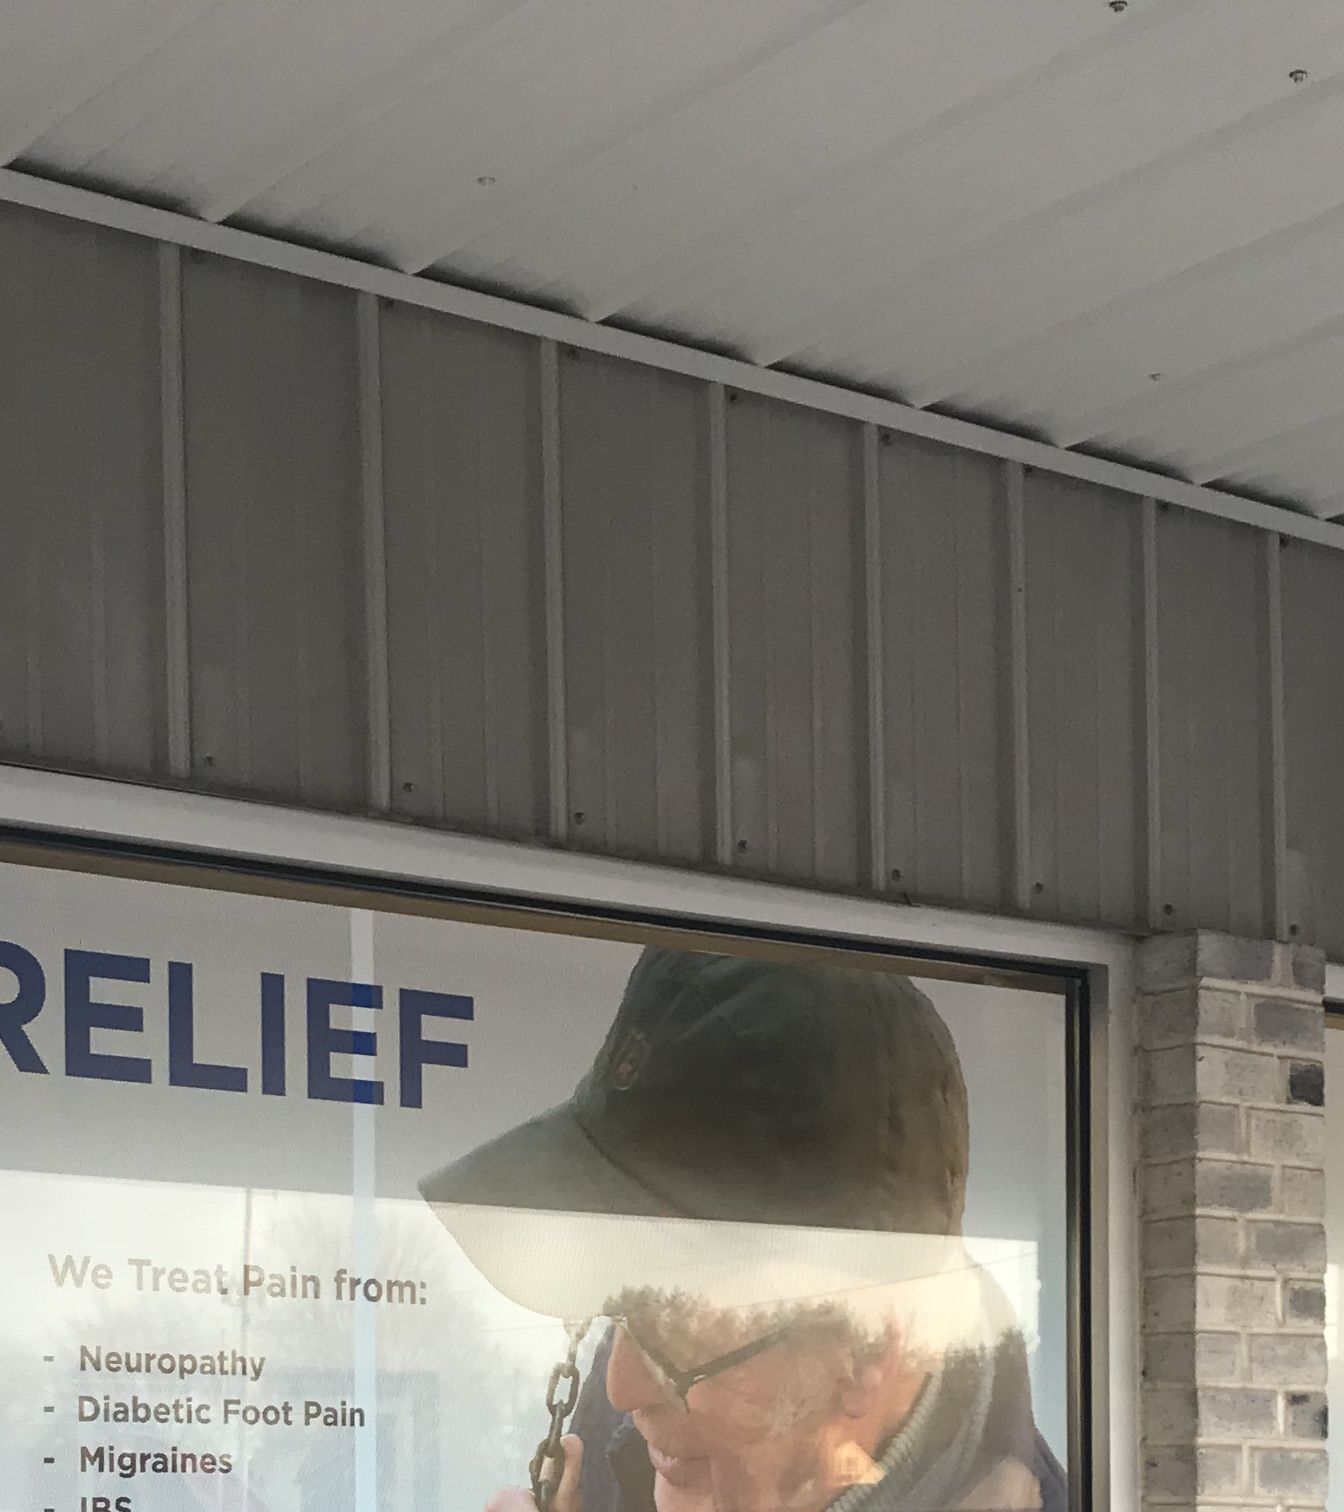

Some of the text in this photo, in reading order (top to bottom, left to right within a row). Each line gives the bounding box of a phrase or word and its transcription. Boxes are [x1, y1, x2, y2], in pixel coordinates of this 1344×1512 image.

[48, 1252, 428, 1305] We Treat Pain from:
[79, 1344, 266, 1380] Neuropathy
[77, 1395, 211, 1425] Diabetic
[222, 1399, 293, 1427] Foot
[303, 1400, 365, 1428] Pain
[80, 1447, 233, 1477] Migraines
